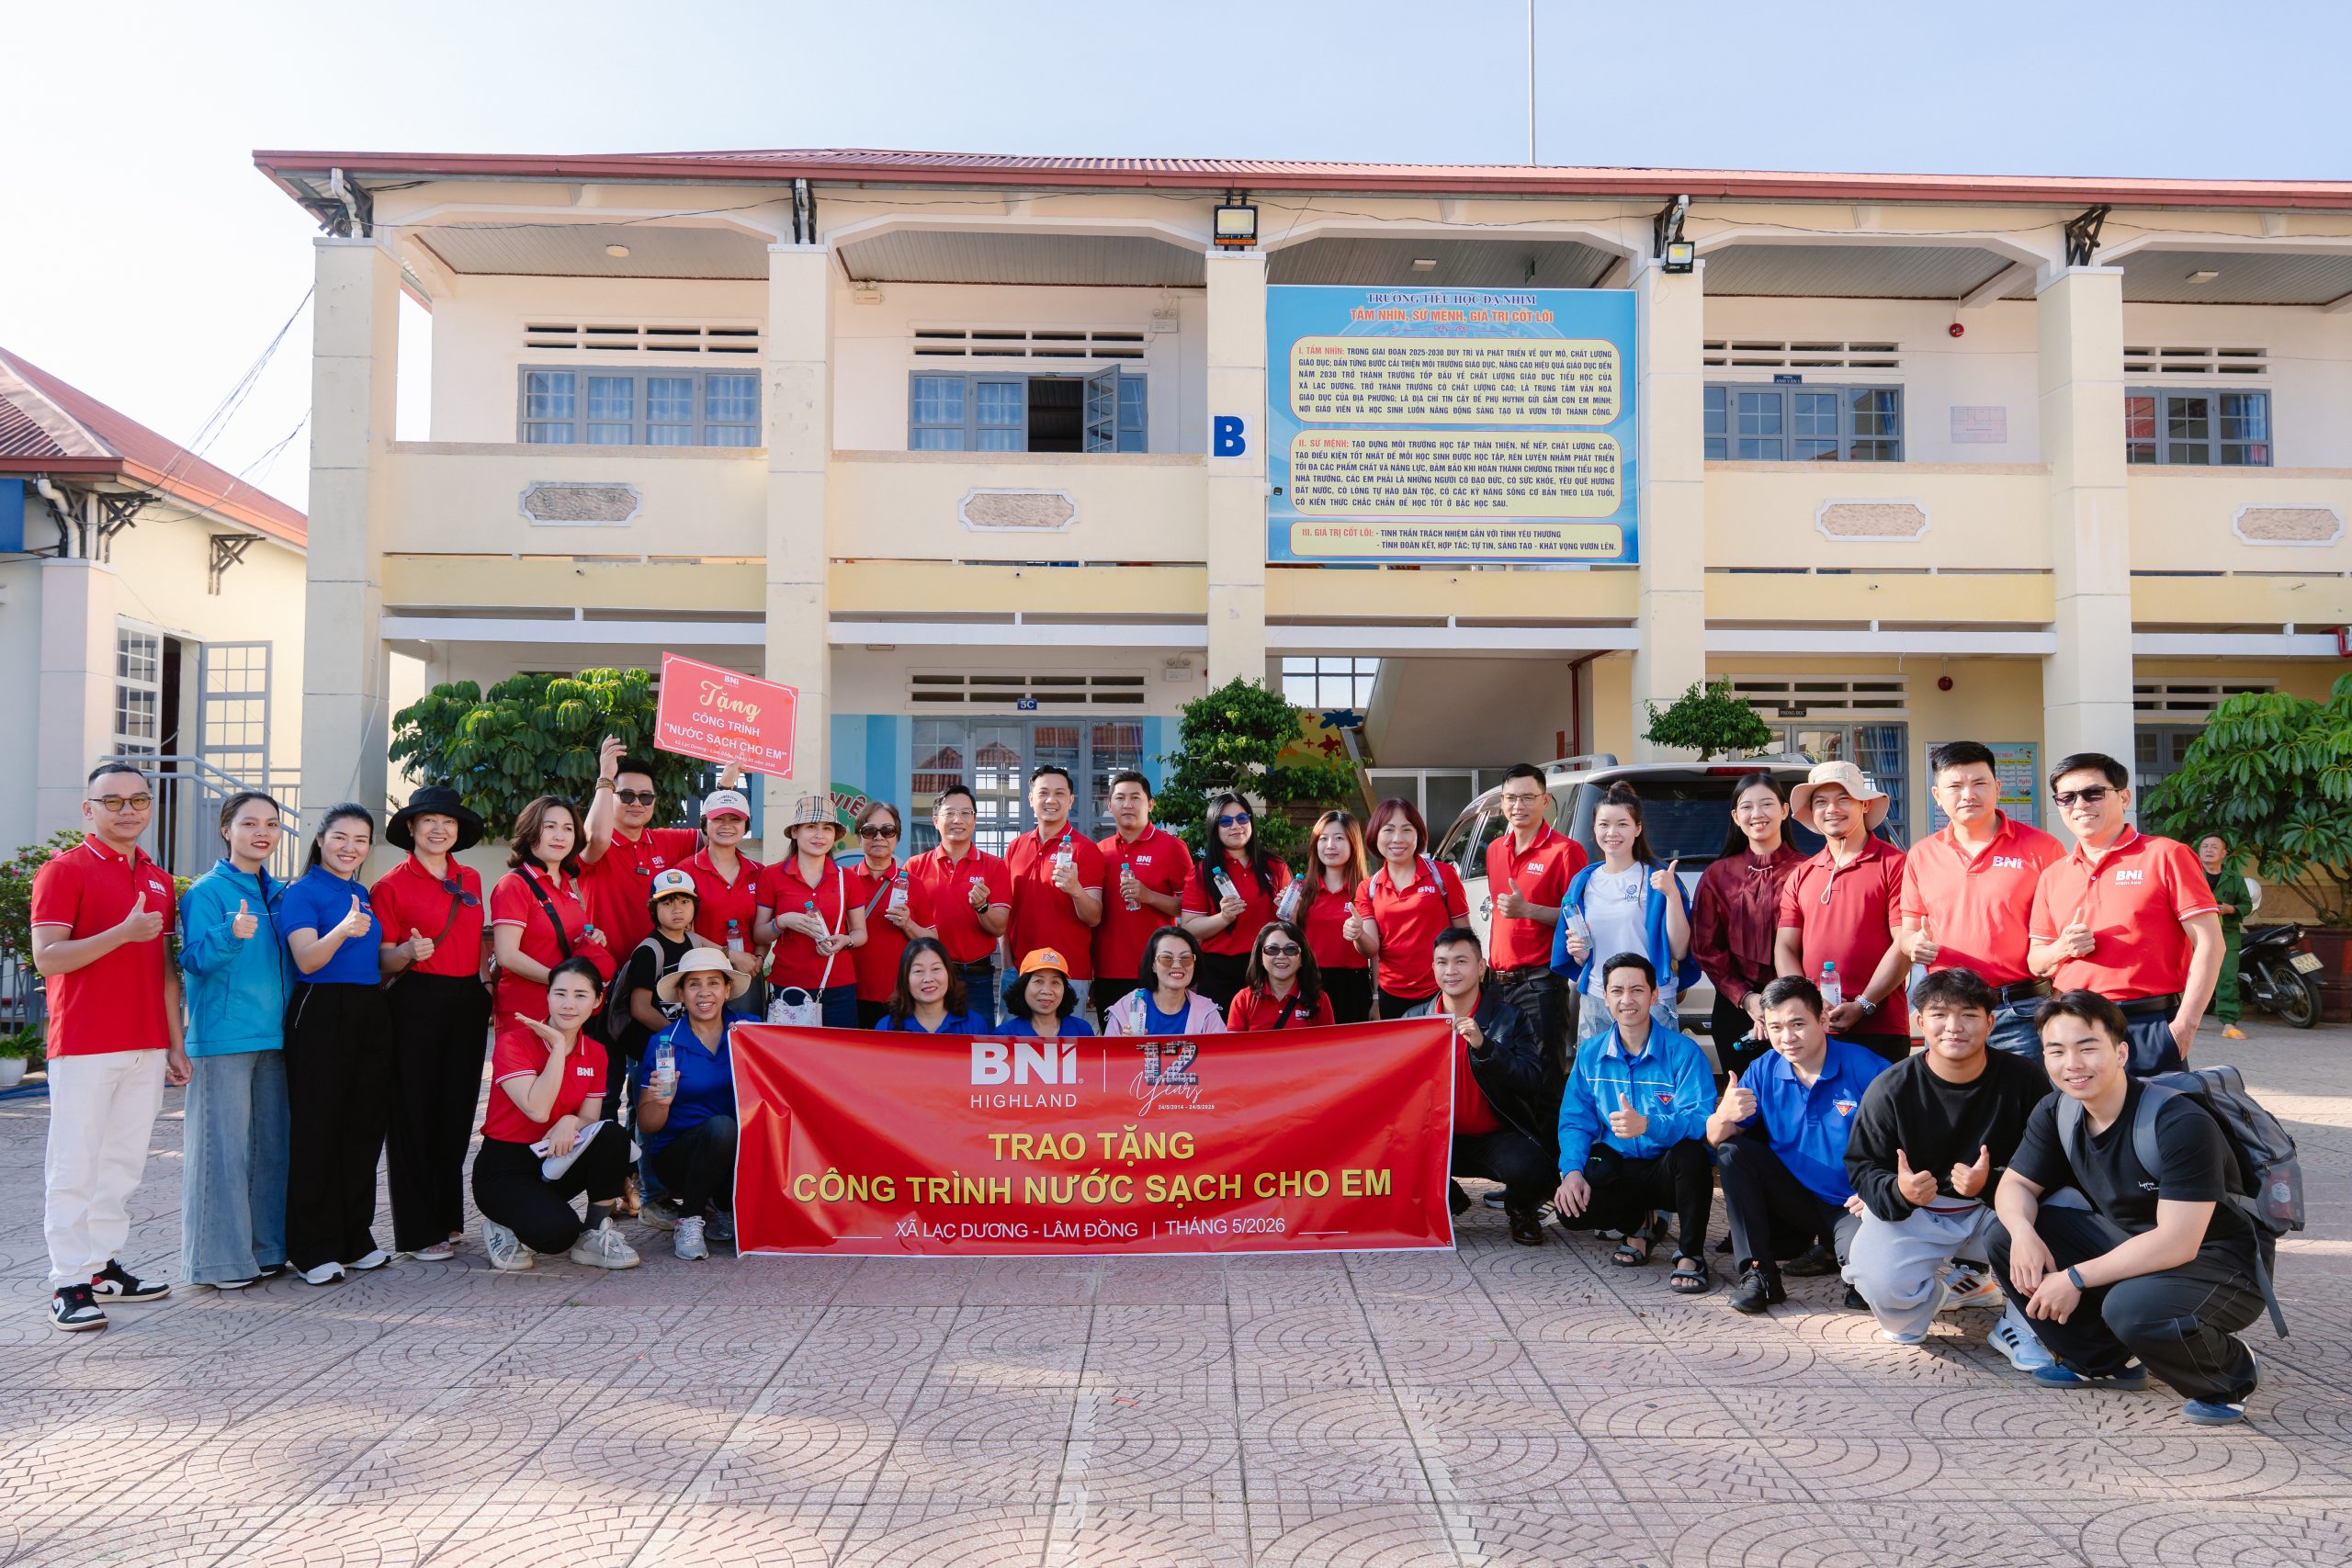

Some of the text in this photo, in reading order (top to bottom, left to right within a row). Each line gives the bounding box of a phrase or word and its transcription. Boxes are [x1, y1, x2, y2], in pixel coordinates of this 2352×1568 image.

[1351, 305, 1374, 320] TẦM
[1470, 310, 1487, 321] GIÁ
[1492, 311, 1509, 323] TRỊ
[1512, 309, 1532, 321] CỐT
[1454, 295, 1482, 306] HỌC
[1504, 296, 1536, 304] NHIM
[1214, 416, 1245, 457] B
[700, 681, 761, 722] Tặng
[664, 722, 786, 760] "NƯỚC SẠCH CHO EM"
[693, 713, 760, 737] CÔNG TRÌNH
[831, 792, 866, 819] VIỆ
[1136, 1041, 1198, 1086] 12
[971, 1094, 1077, 1108] HIGHLAND
[1130, 1071, 1203, 1117] Years
[989, 1124, 1195, 1167] TRAO TẶNG
[793, 1167, 1391, 1209] CÔNG TRÌNH NƯỚC SẠCH CHO EM
[895, 1219, 918, 1237] XÃ
[922, 1223, 956, 1240] LẠC
[962, 1222, 1026, 1237] DƯƠNG
[1044, 1220, 1080, 1237] LÂM
[1084, 1219, 1138, 1237] ĐỒNG
[1165, 1216, 1227, 1235] THÁNG
[1232, 1218, 1285, 1234] 5/2026
